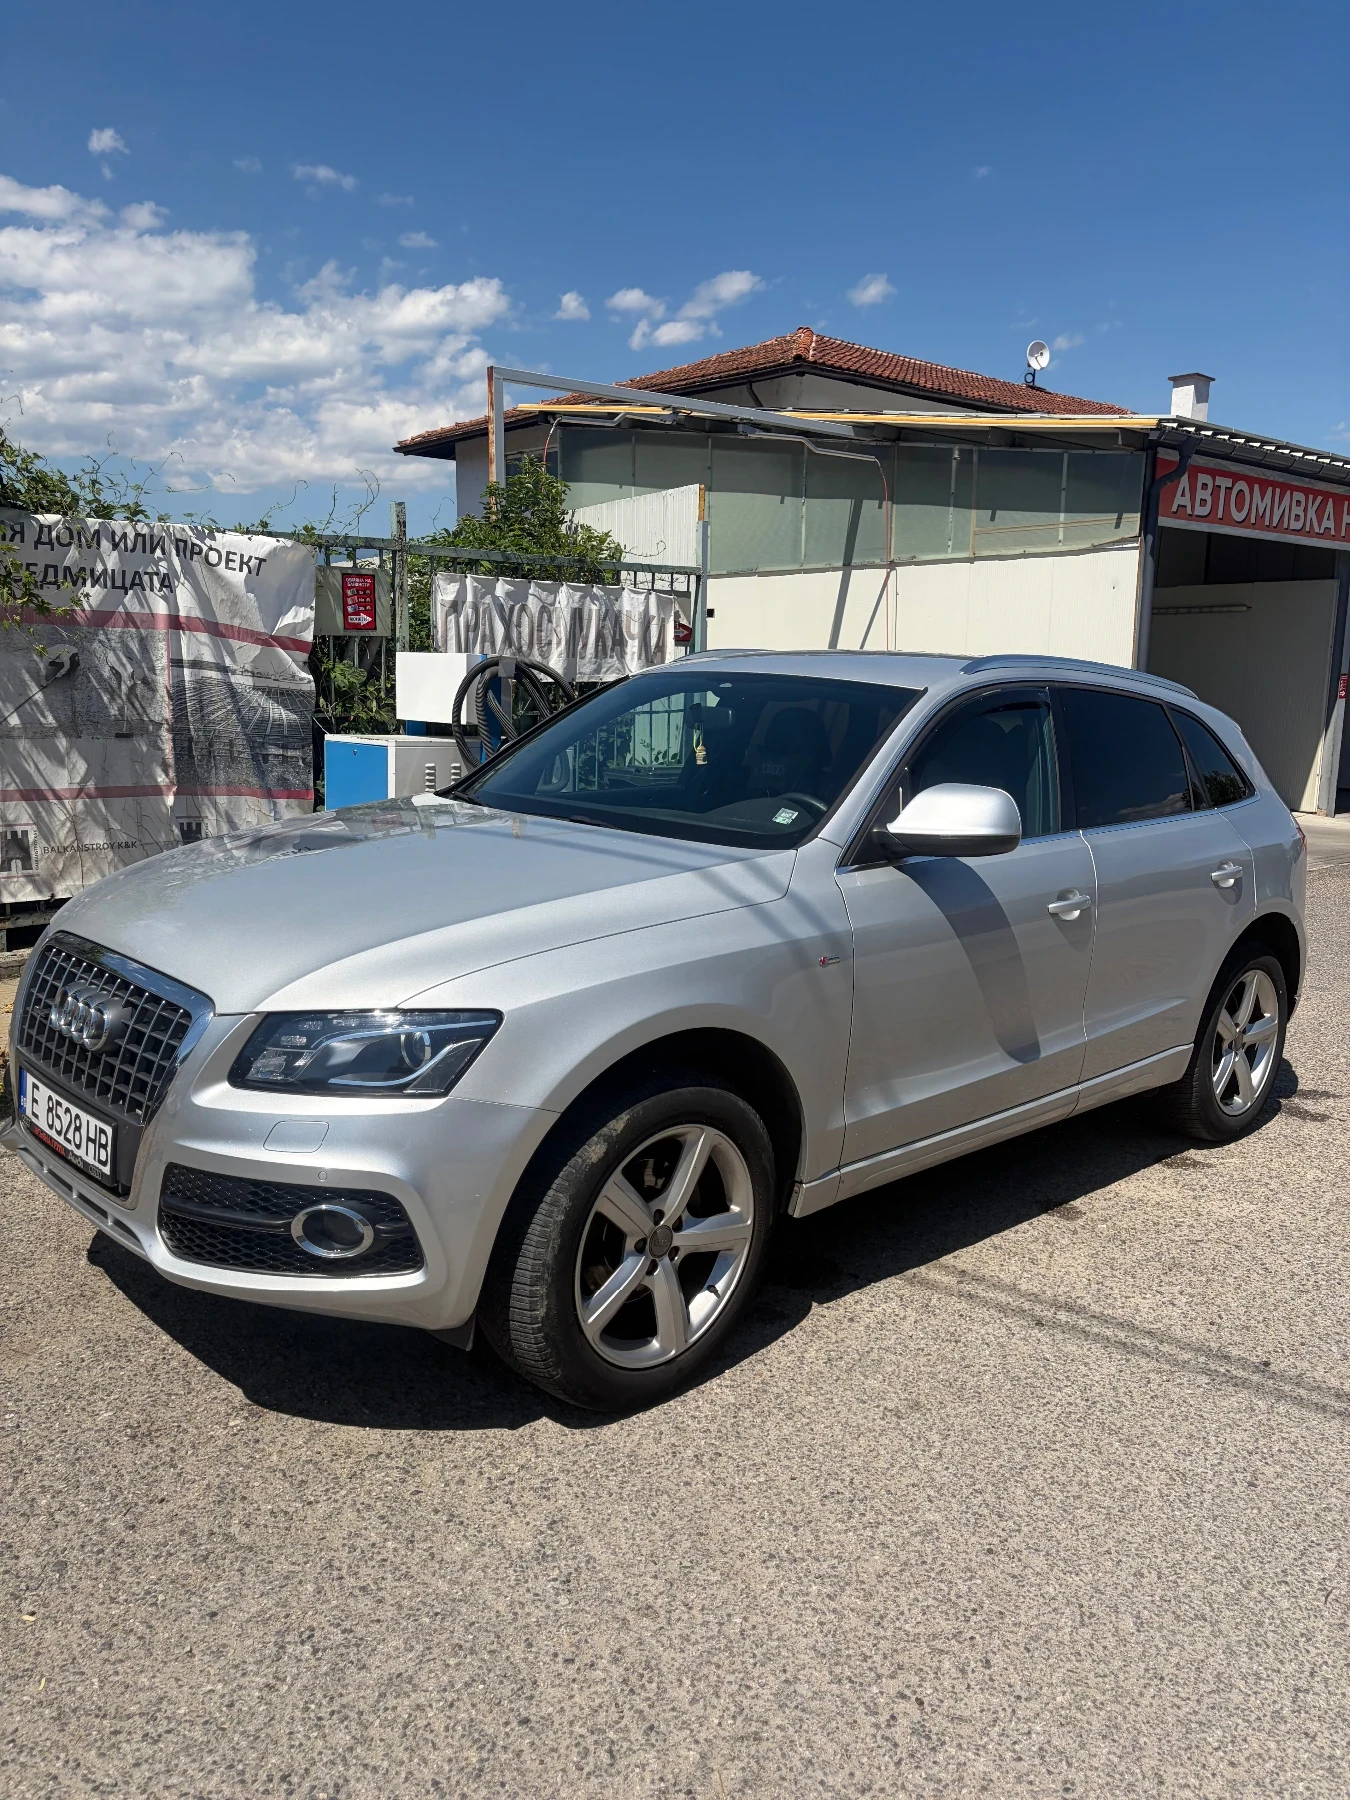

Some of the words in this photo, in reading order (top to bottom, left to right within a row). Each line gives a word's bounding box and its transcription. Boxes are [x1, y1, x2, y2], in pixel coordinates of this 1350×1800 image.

[1171, 471, 1335, 536] АВТОМИВКА
[34, 523, 101, 552] ДОМ
[111, 530, 166, 556] ИЛИ
[175, 538, 267, 577] ПРОЕКТ
[12, 562, 174, 595] ЕДМИЦАТА
[43, 842, 116, 854] BALKANSTROY
[117, 840, 138, 849] K&K
[31, 1081, 41, 1121] E
[46, 1094, 83, 1151] 8528
[85, 1119, 109, 1168] HB
[68, 1151, 84, 1169] Audi
